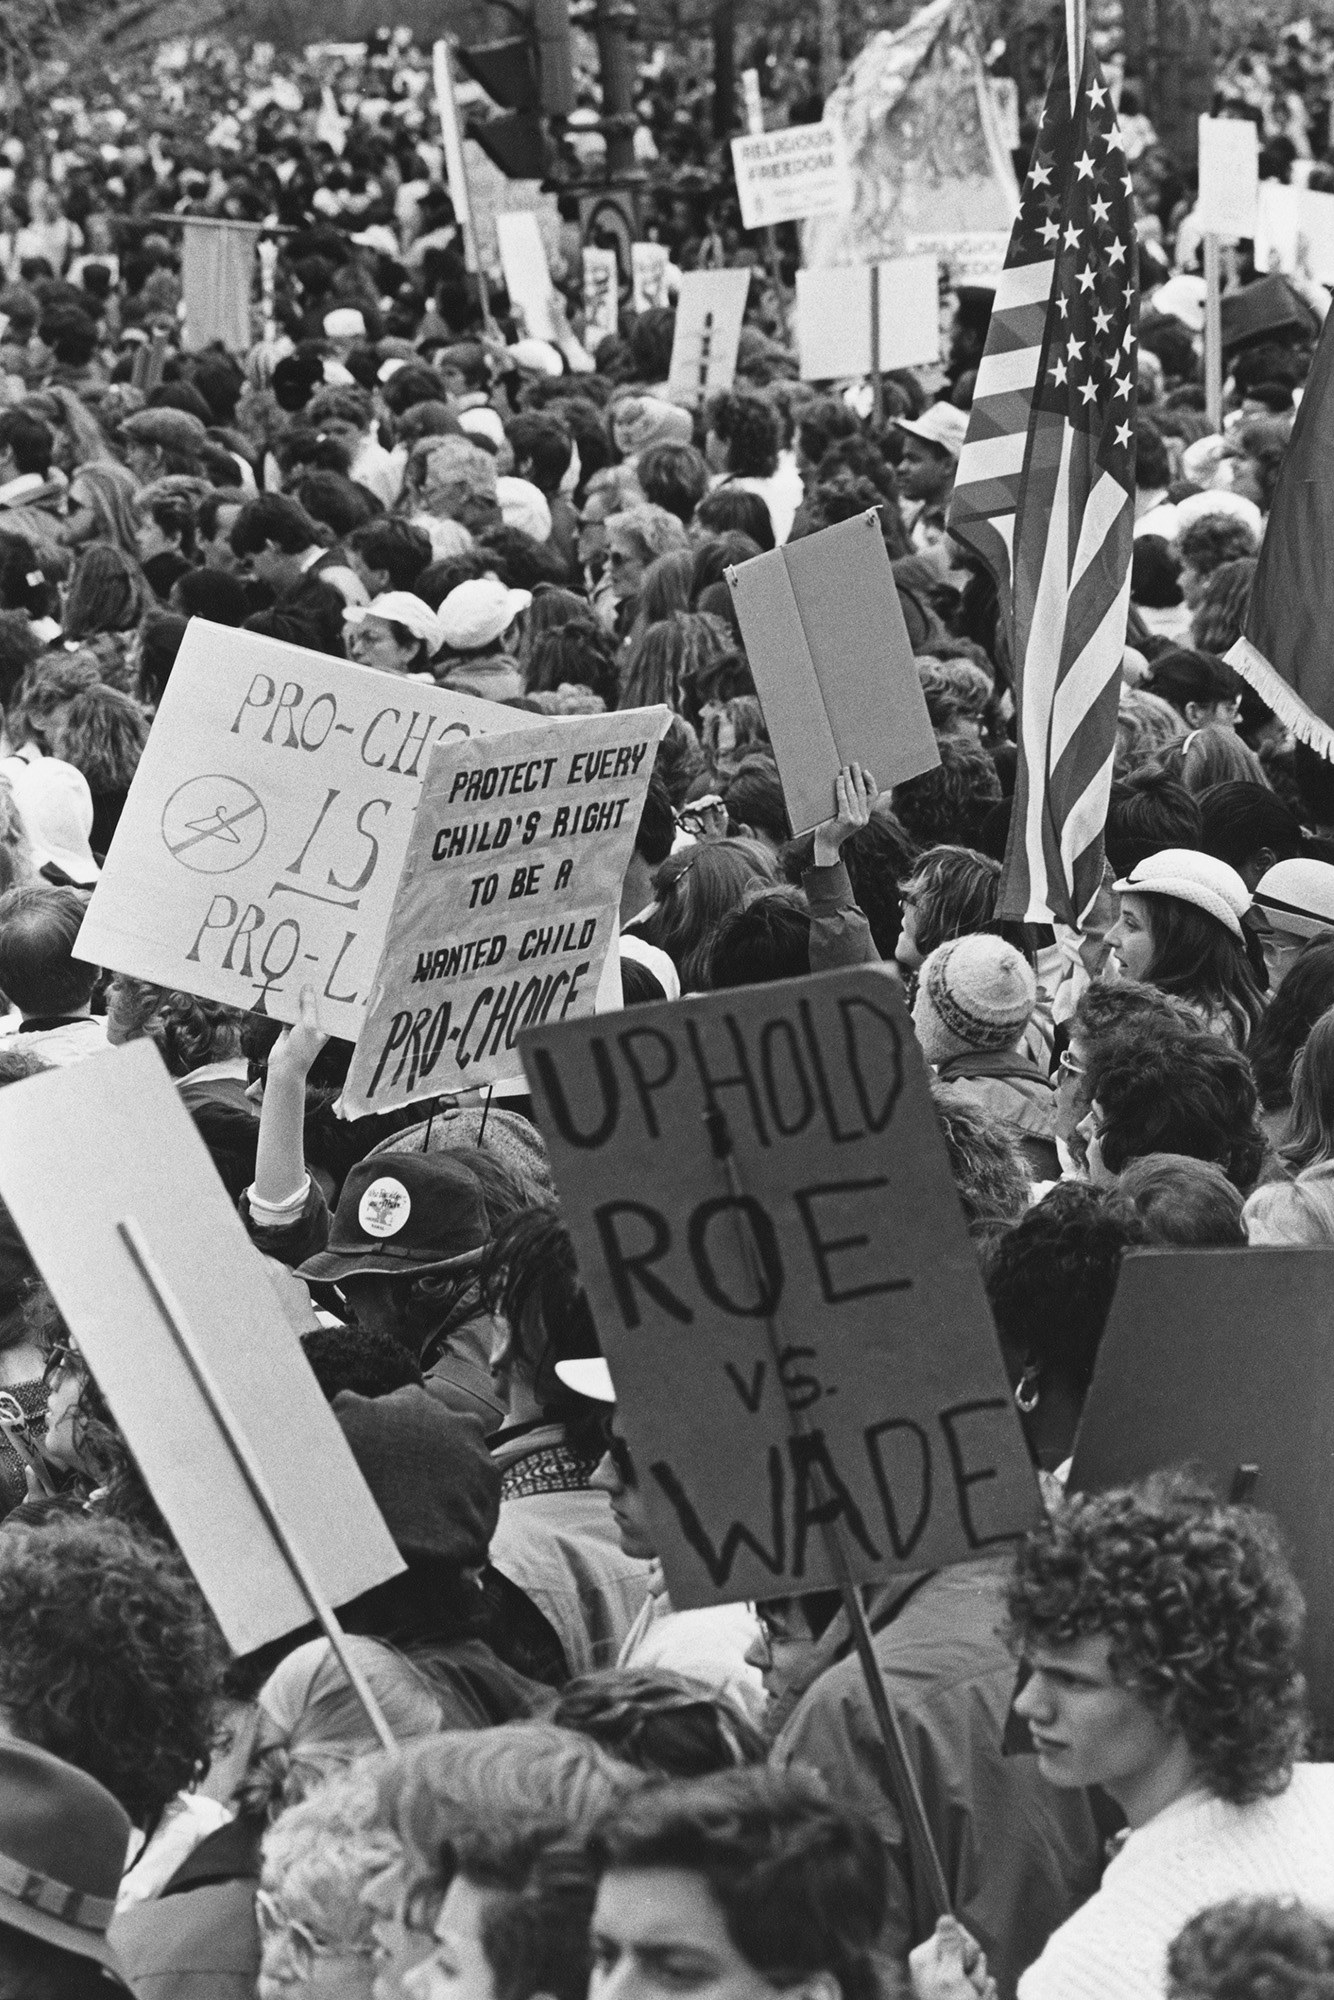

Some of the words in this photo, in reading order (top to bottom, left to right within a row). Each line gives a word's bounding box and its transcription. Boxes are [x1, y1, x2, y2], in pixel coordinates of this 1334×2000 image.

[742, 130, 834, 158] RELIGIOUS
[748, 153, 835, 179] FREEDOM
[448, 757, 558, 804] PROTECT
[566, 741, 649, 785] EVERY
[284, 787, 393, 892] IS
[431, 810, 542, 862] CHILD'S
[550, 797, 631, 839] RIGHT
[468, 872, 500, 909] TO
[507, 863, 545, 900] BE
[553, 858, 574, 891] A
[185, 894, 369, 1015] PRO-L
[410, 934, 508, 984] WANTED
[517, 918, 598, 962] CHILD
[533, 995, 904, 1150] UPHOLD
[593, 1176, 913, 1330] ROE
[649, 1397, 1029, 1589] WADE
